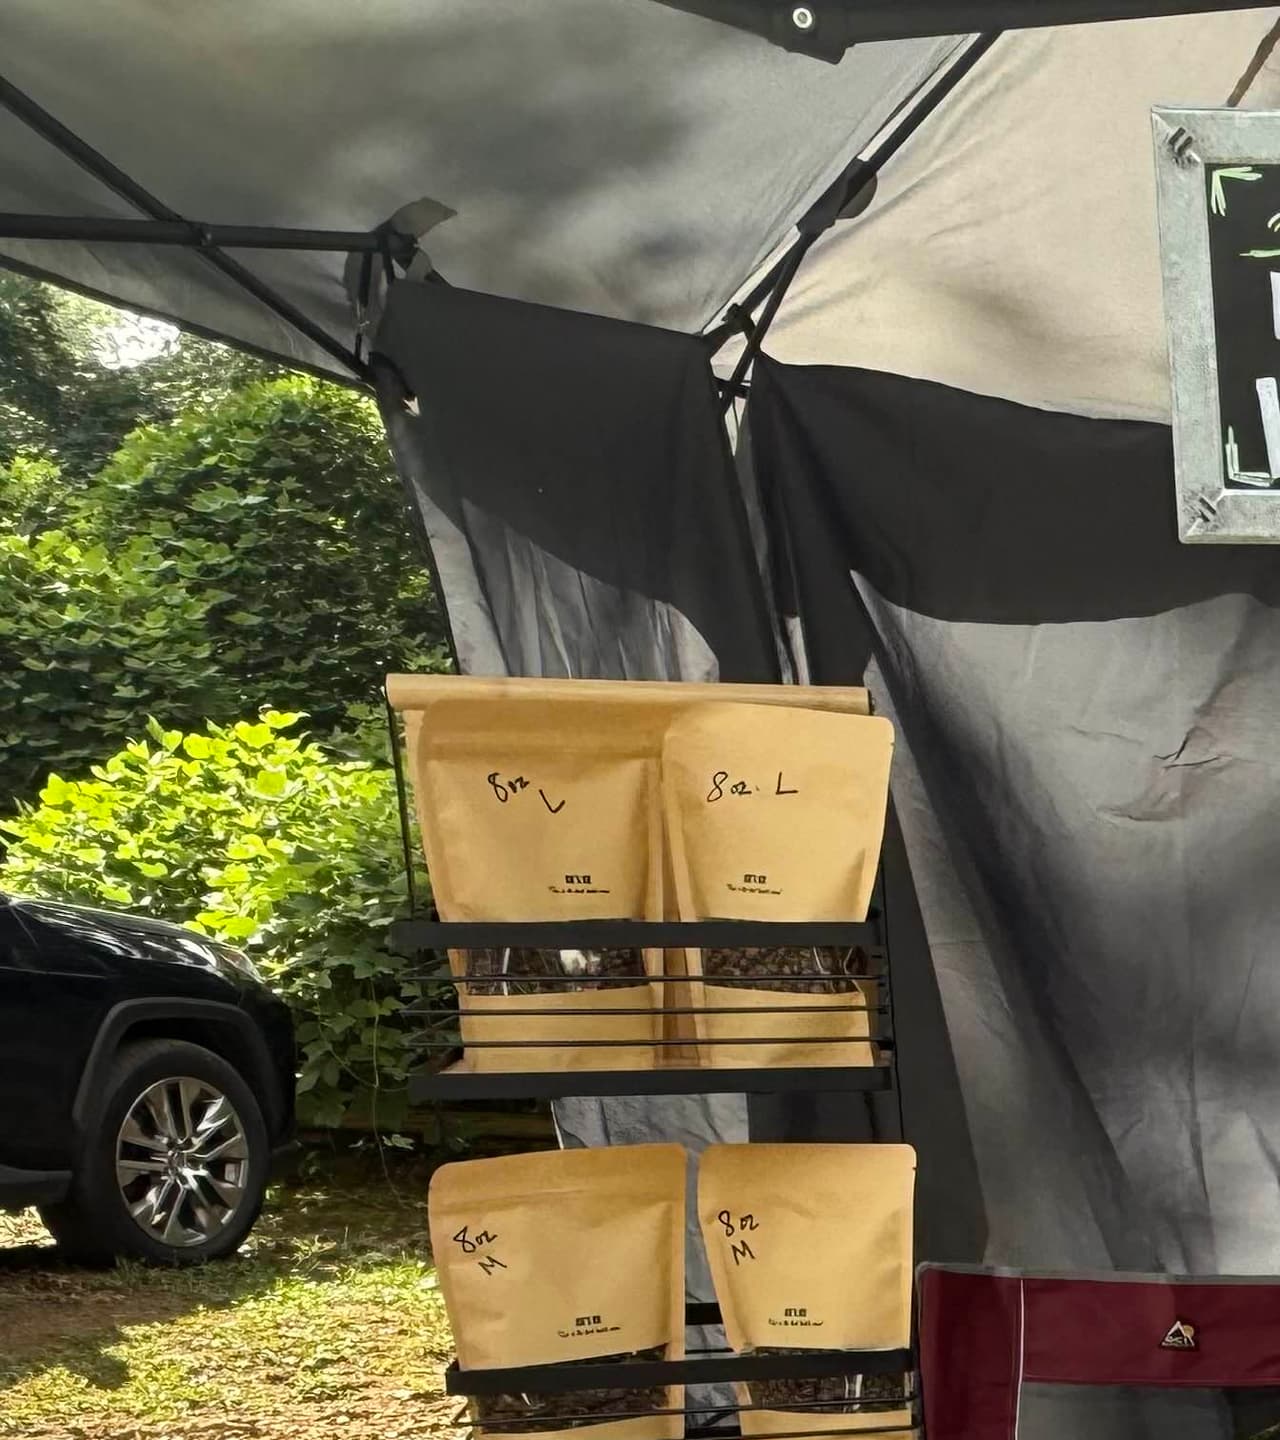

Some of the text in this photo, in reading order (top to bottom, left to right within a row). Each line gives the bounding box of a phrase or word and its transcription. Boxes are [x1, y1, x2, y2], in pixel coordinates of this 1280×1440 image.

[774, 771, 800, 796] L
[730, 1240, 757, 1266] M
[478, 1255, 508, 1277] M
